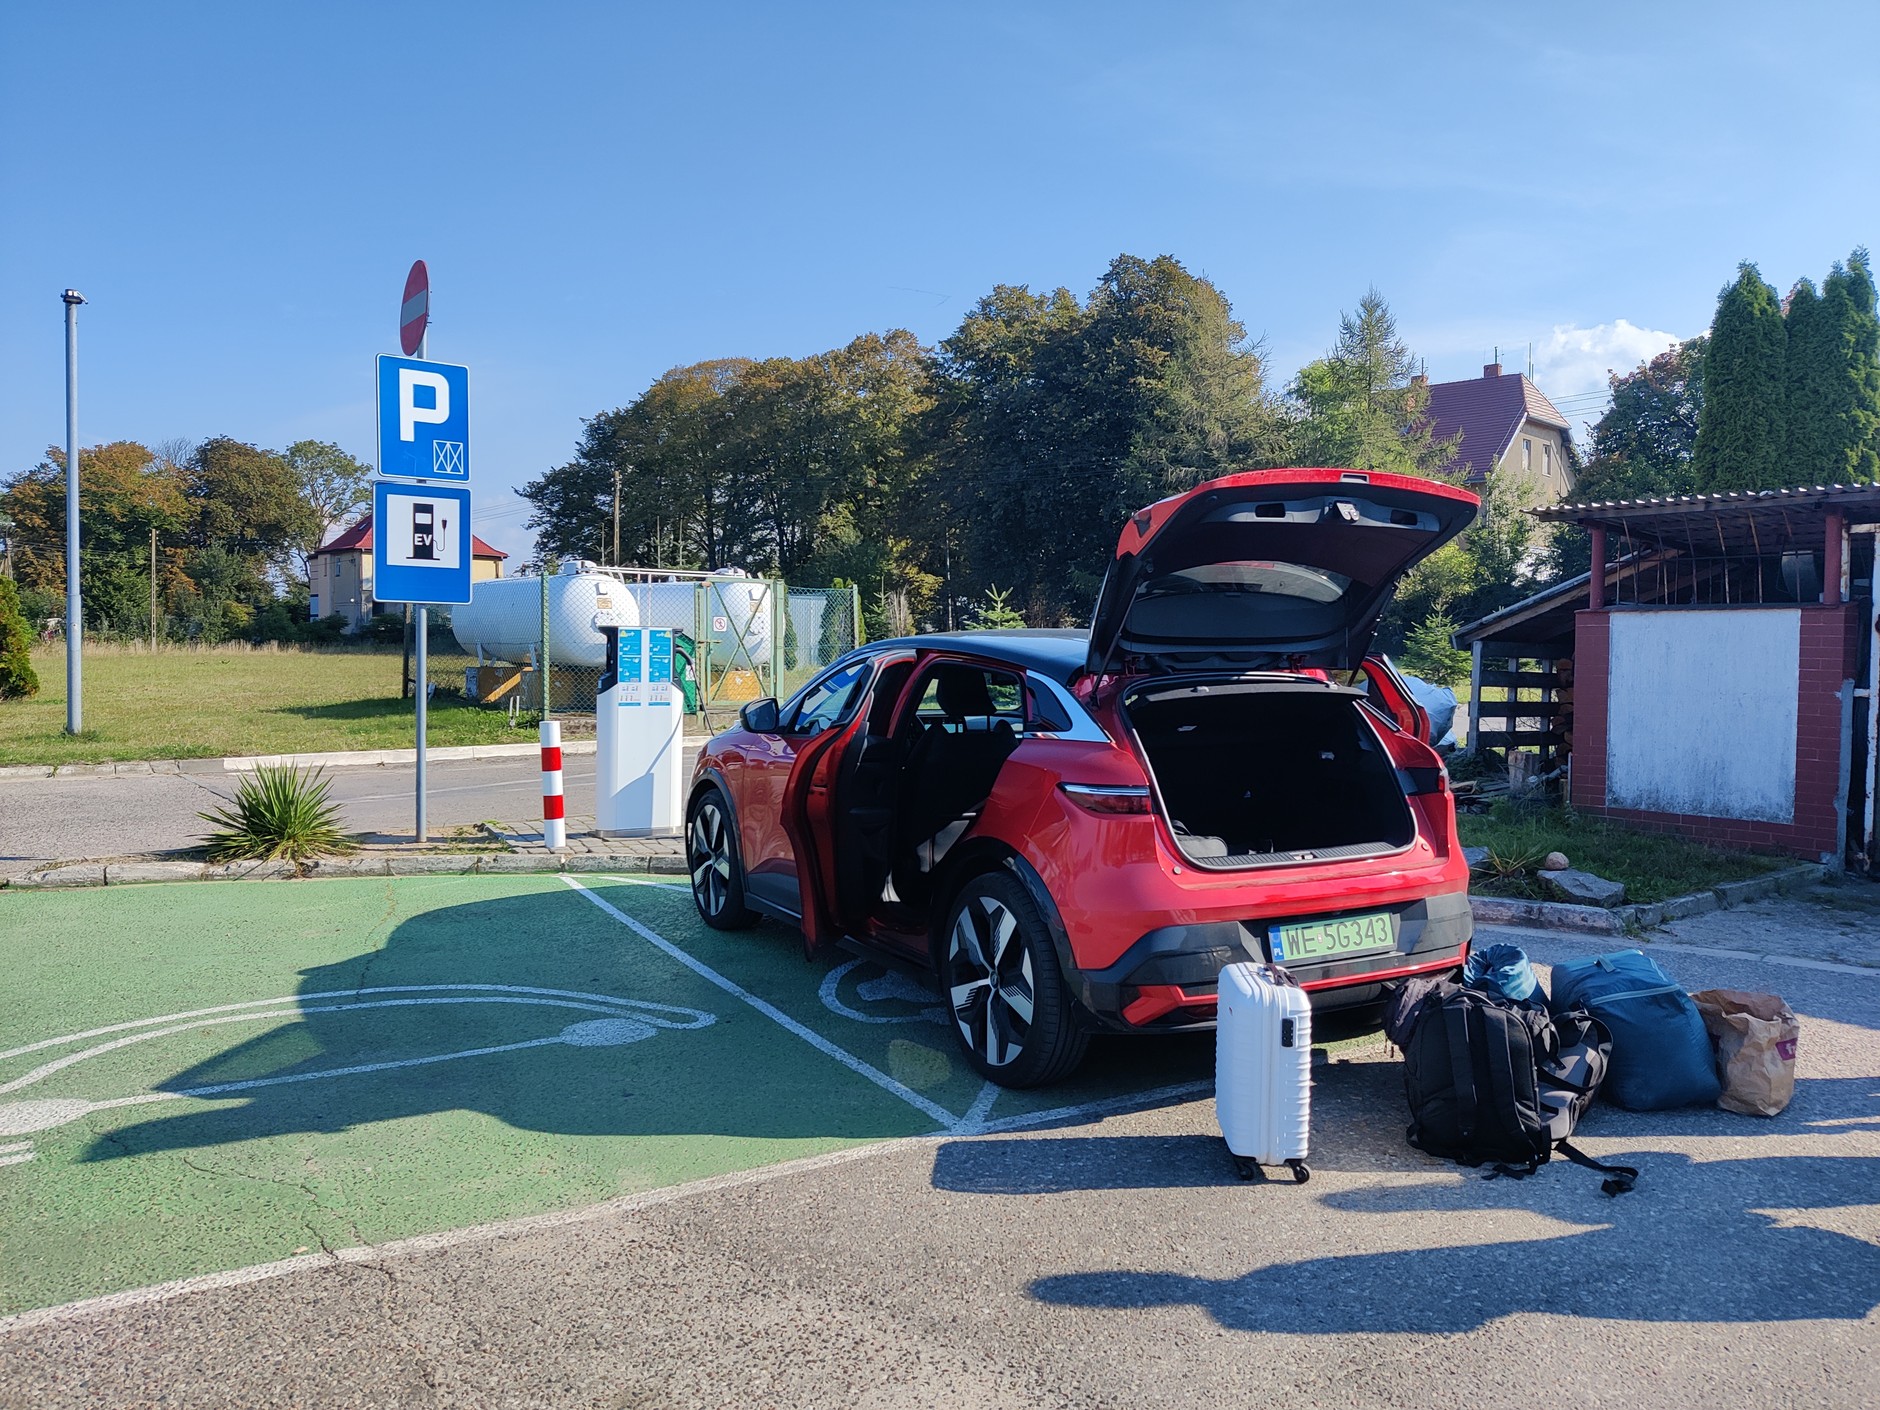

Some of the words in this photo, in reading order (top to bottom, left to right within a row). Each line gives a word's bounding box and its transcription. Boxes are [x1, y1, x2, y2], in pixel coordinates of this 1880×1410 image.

[399, 368, 450, 442] P
[414, 533, 433, 546] EV
[1286, 926, 1317, 956] WE
[1323, 917, 1388, 951] 5G343
[1273, 947, 1283, 956] PL
